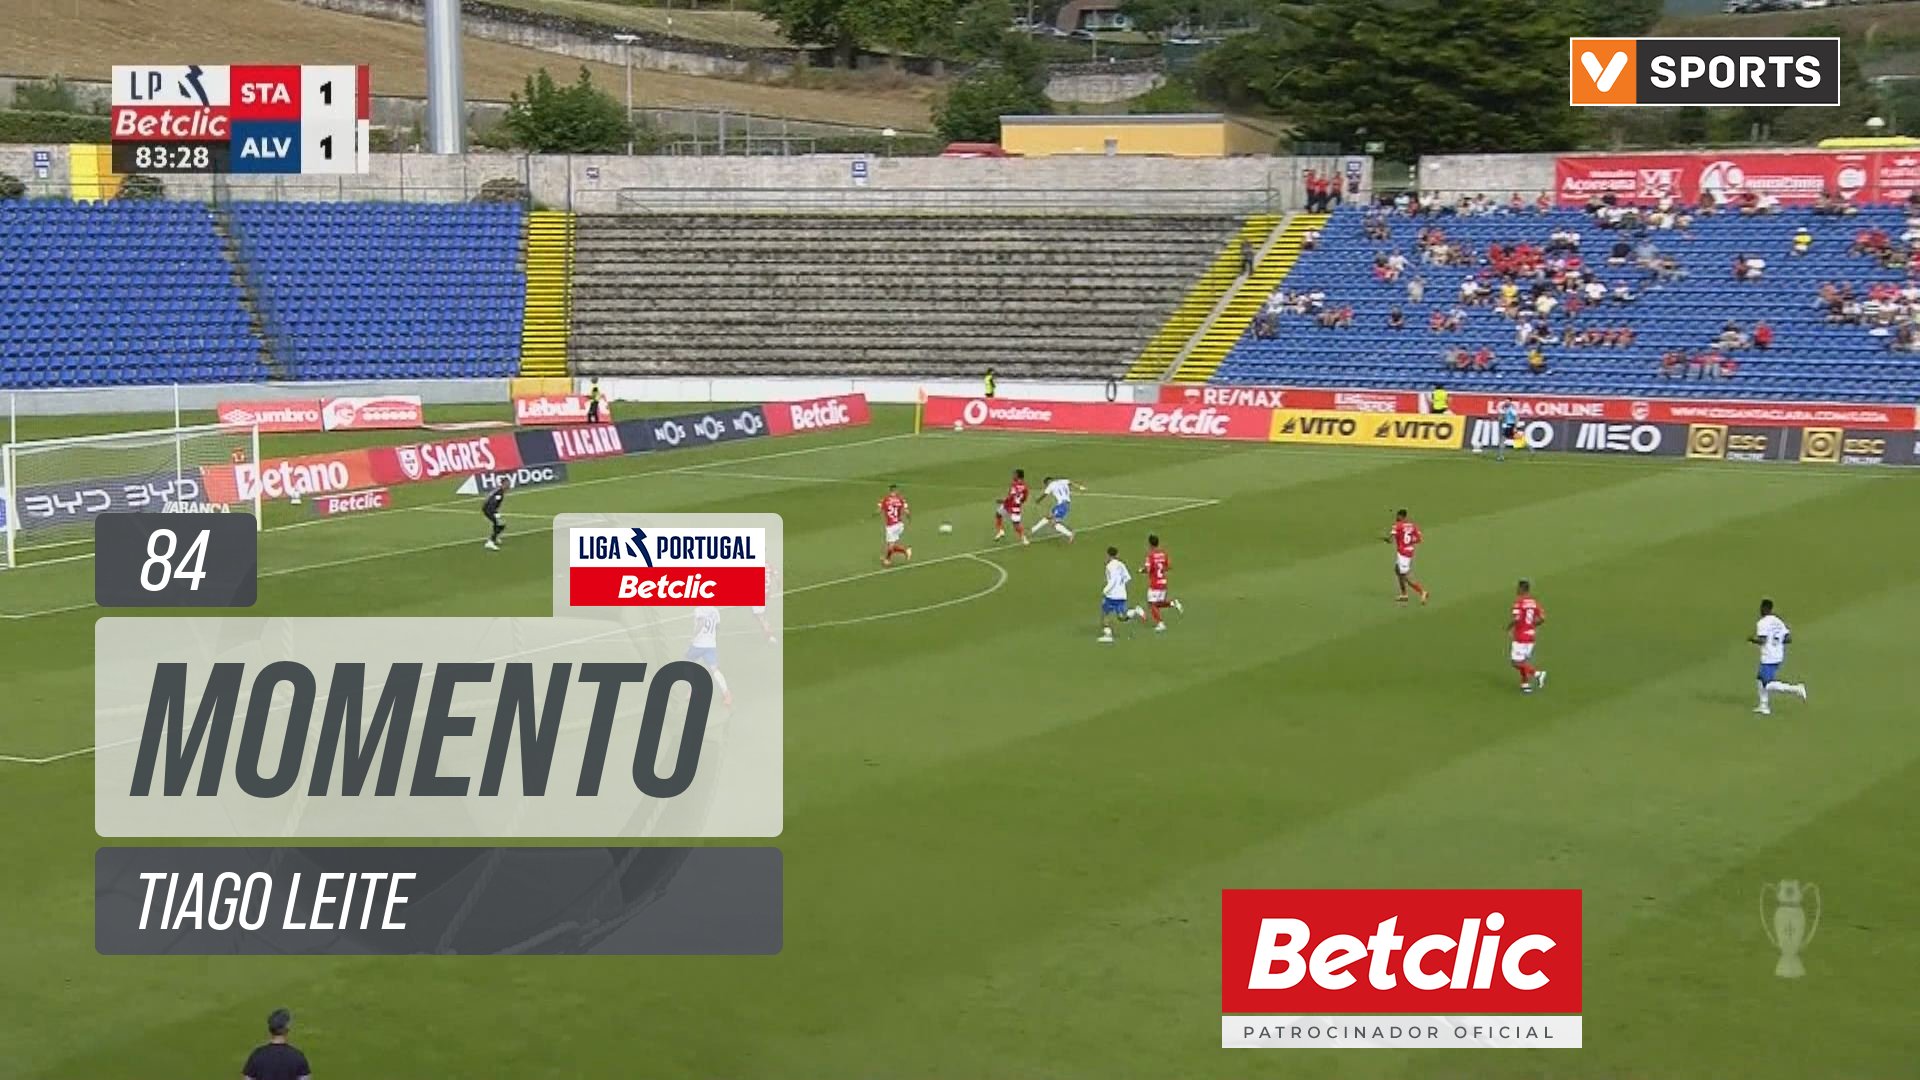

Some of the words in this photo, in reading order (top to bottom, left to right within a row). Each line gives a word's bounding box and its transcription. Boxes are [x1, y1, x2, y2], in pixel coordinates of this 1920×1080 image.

[1203, 388, 1285, 409] RE/MAX
[1535, 401, 1604, 417] ONLINE
[254, 406, 319, 423] umbro
[732, 410, 763, 435] NOS
[790, 399, 850, 430] Betclic
[989, 406, 1052, 422] vodafone
[1130, 406, 1231, 435] Betclic
[1300, 417, 1356, 436] VITO
[655, 420, 686, 446] NOS
[693, 415, 726, 441] NOS
[1395, 420, 1453, 440] VITO
[1575, 422, 1662, 452] MEO
[552, 426, 622, 457] PLACARD
[1727, 434, 1768, 451] ESC
[1843, 438, 1886, 455] ESC
[421, 437, 496, 477] SAGRES
[233, 459, 349, 501] Betano
[24, 488, 112, 516] BYD
[327, 494, 384, 515] Betclic
